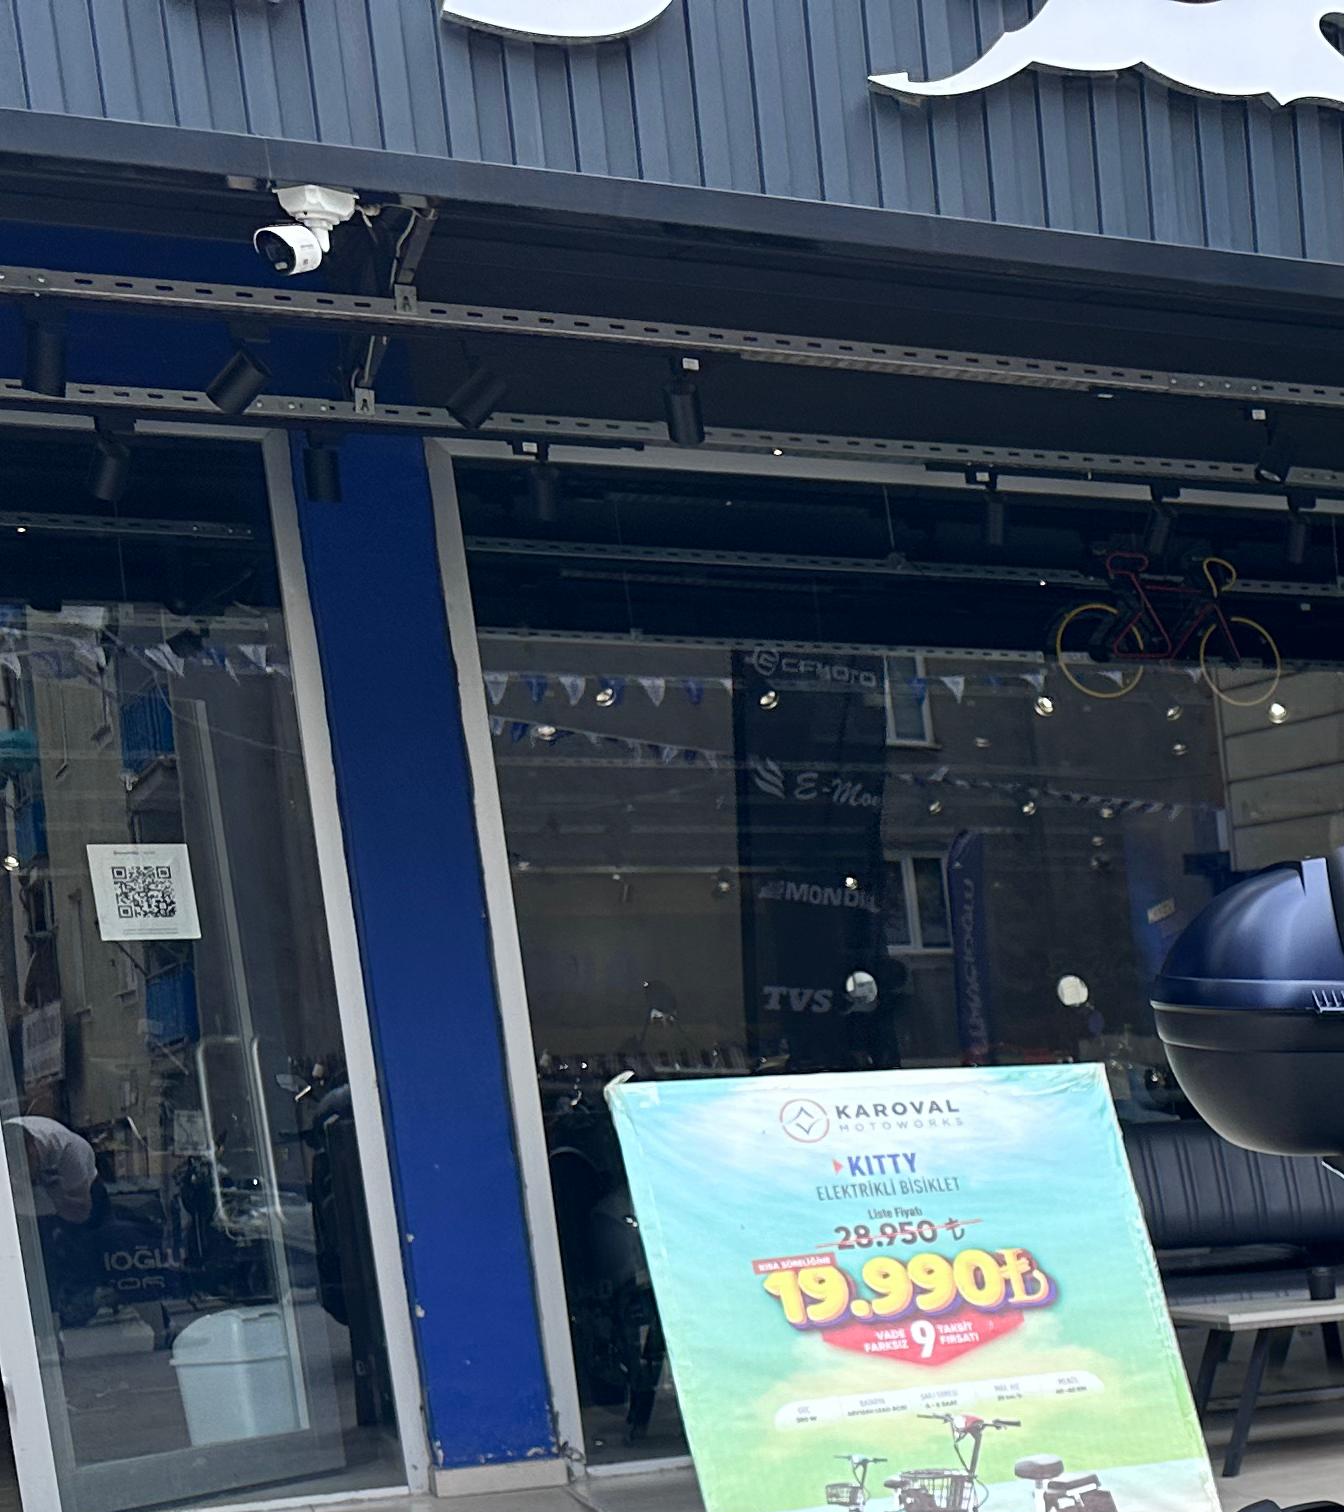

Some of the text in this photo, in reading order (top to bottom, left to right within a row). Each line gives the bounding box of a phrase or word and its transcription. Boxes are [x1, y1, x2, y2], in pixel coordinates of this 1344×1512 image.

[762, 985, 834, 1013] TVS
[835, 1099, 960, 1120] KAROVAL
[839, 1116, 964, 1133] MOTOWORKS
[847, 1152, 917, 1177] KITTY
[815, 1176, 961, 1201] ELEKTRİKLİ BİSİKLET
[867, 1205, 923, 1220] Liste Fiyatı
[833, 1220, 938, 1251] 28.950
[910, 1319, 936, 1358] 9
